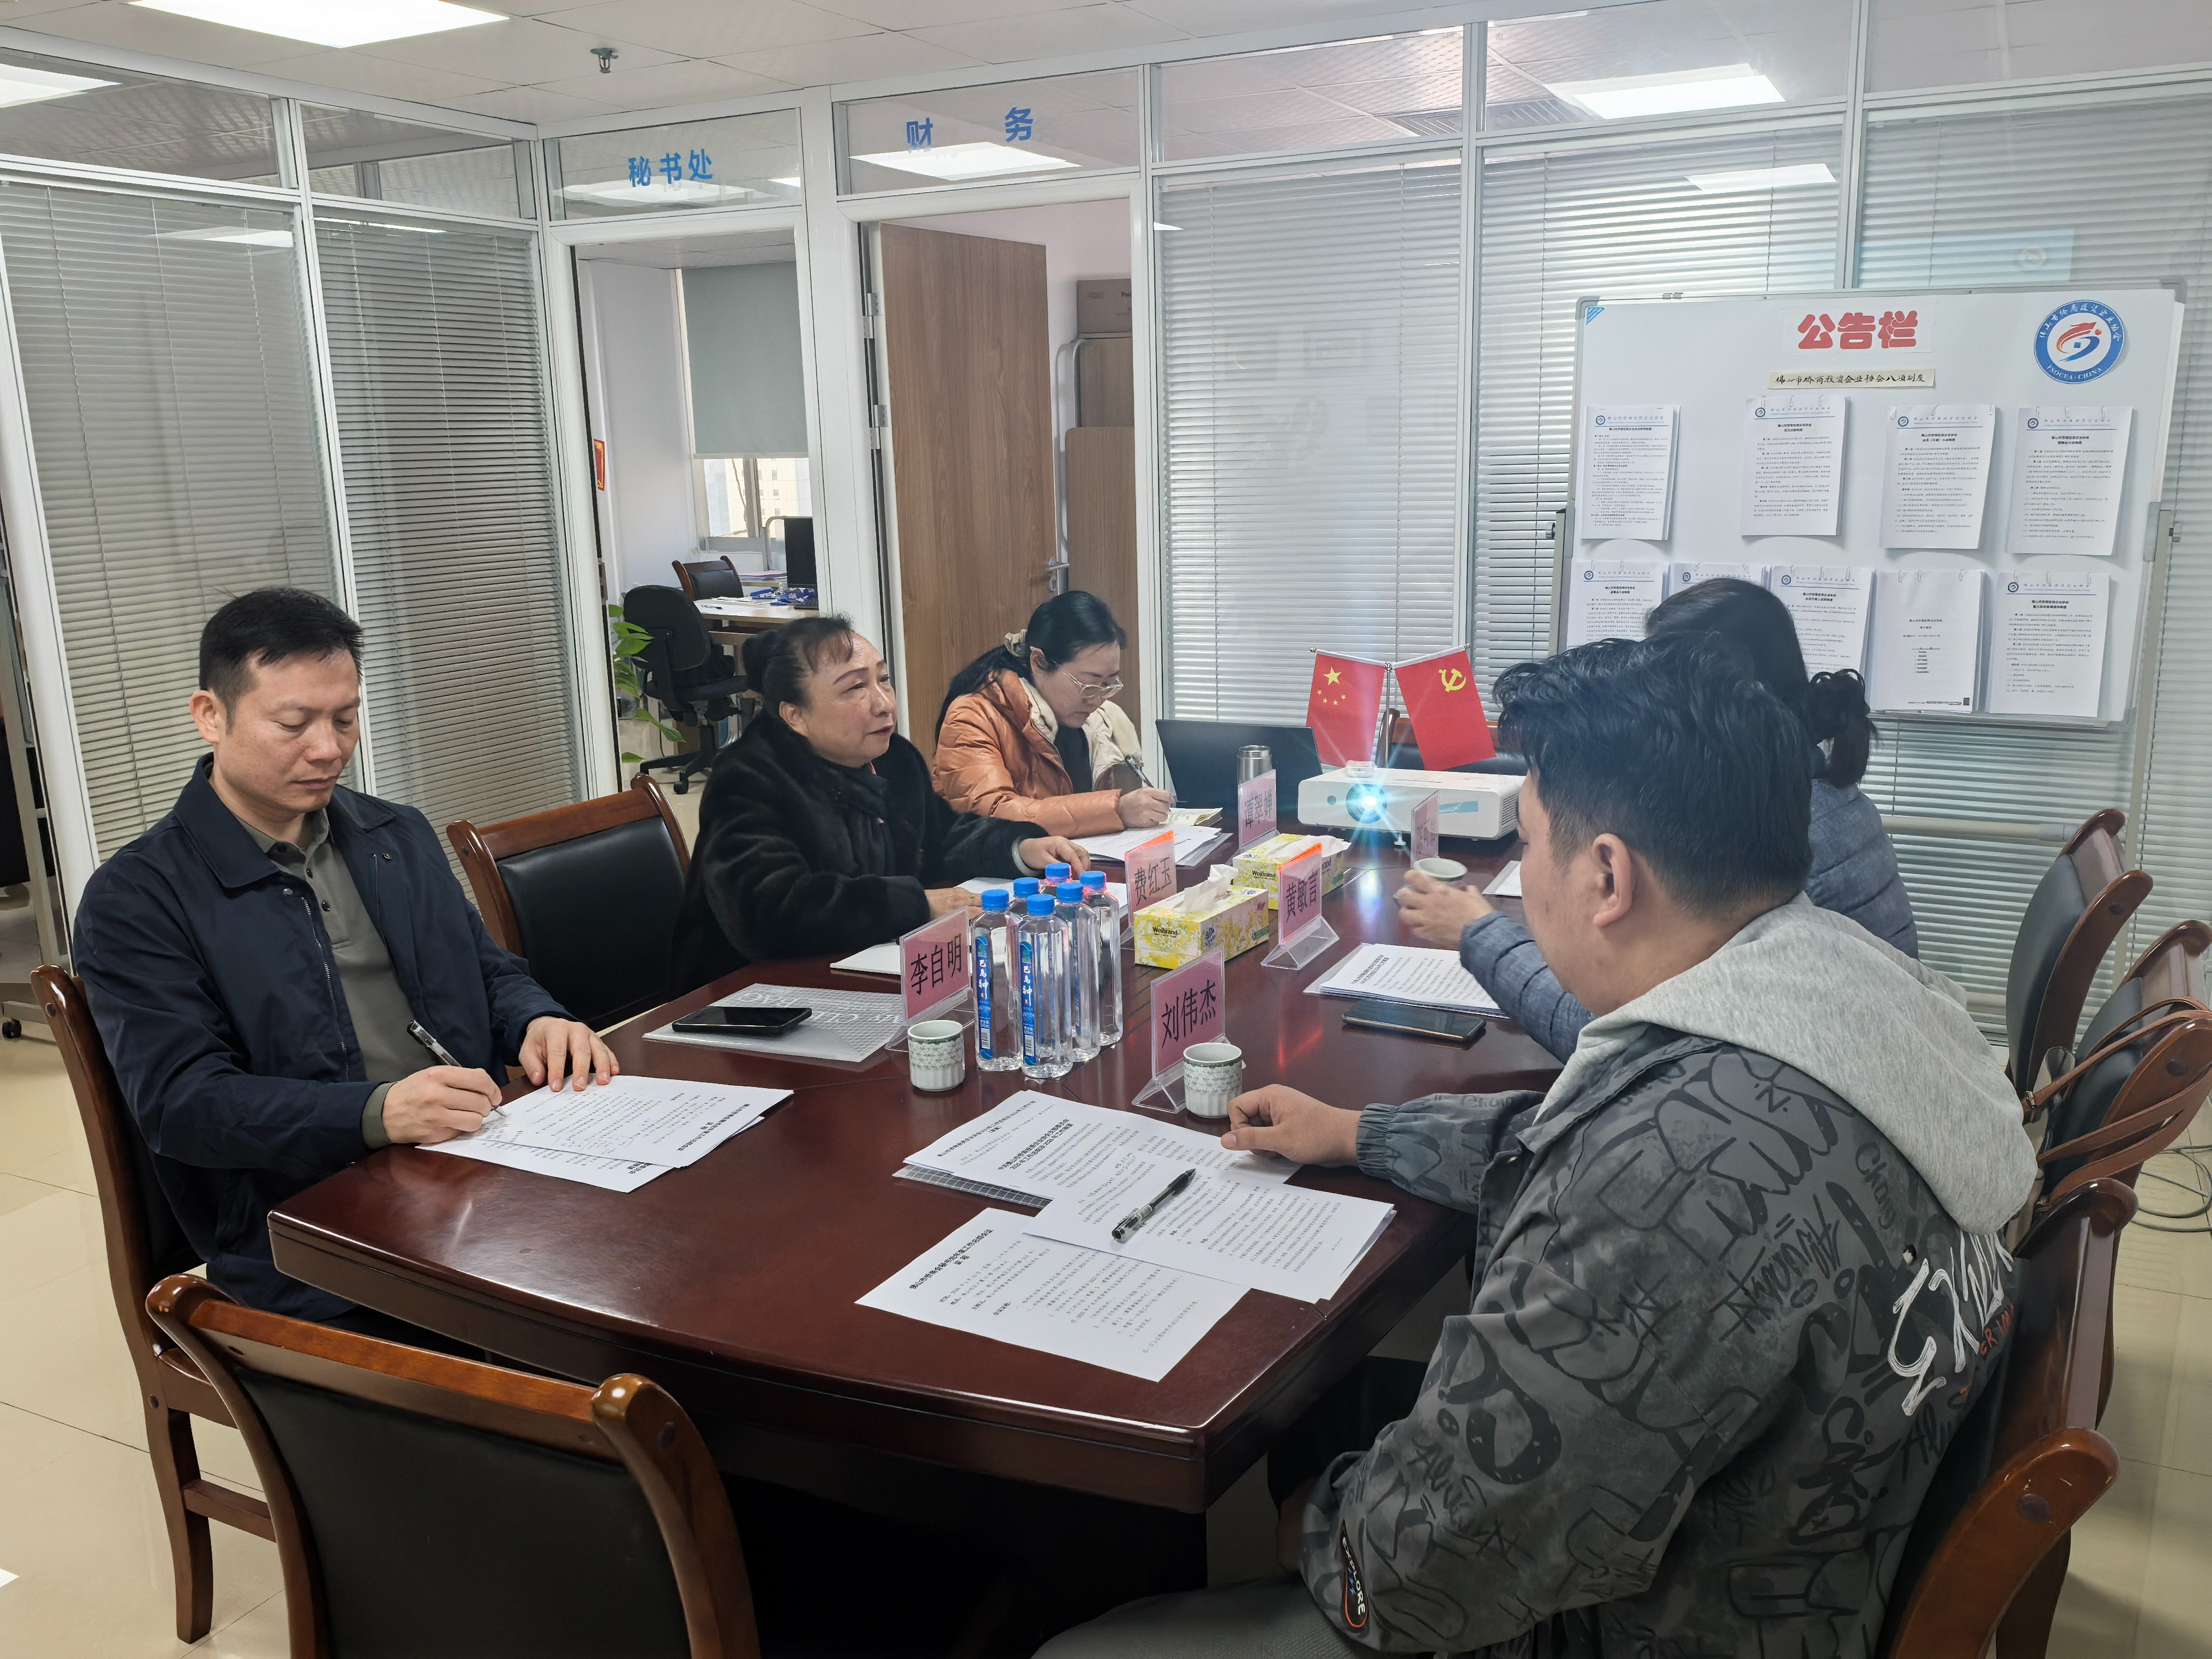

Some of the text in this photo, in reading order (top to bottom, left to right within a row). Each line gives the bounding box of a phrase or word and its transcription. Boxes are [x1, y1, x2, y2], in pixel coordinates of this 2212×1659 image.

[907, 107, 1033, 151] 财务
[628, 149, 713, 187] 秘书处
[1798, 311, 1918, 349] 公告栏
[1135, 857, 1172, 906] 费红玉
[1286, 869, 1318, 923] 黄敏言
[1152, 926, 1178, 935] Weibrand
[911, 933, 962, 995] 李自明
[1162, 979, 1217, 1049] 刘伟杰
[1343, 1536, 1365, 1615] EXPLORE
